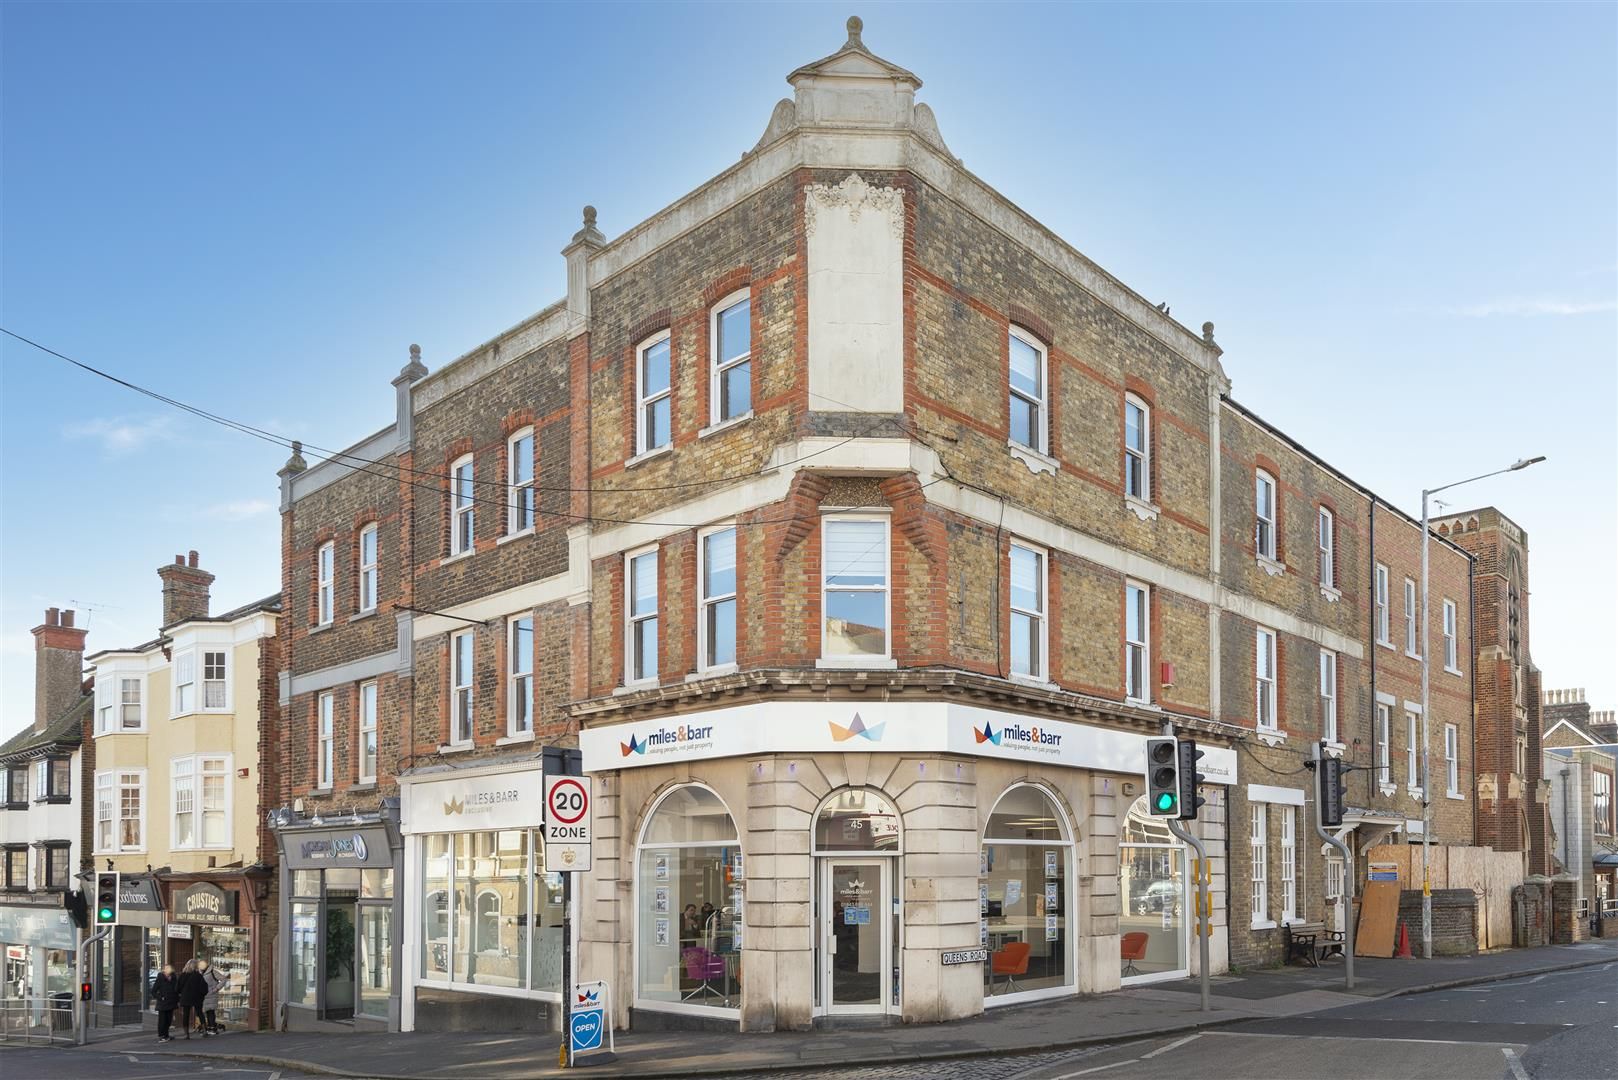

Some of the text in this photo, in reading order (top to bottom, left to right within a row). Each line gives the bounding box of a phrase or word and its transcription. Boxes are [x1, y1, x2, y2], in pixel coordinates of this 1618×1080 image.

[648, 724, 713, 746] miles&barr
[1004, 724, 1062, 746] miles&barr
[464, 790, 519, 806] MILES&BARR
[556, 792, 582, 811] 20
[551, 826, 586, 838] ZONE
[850, 820, 863, 829] 45
[186, 892, 220, 914] CRUSTIES
[943, 950, 987, 963] QUEENS ROAD
[575, 1023, 596, 1033] OPEN
